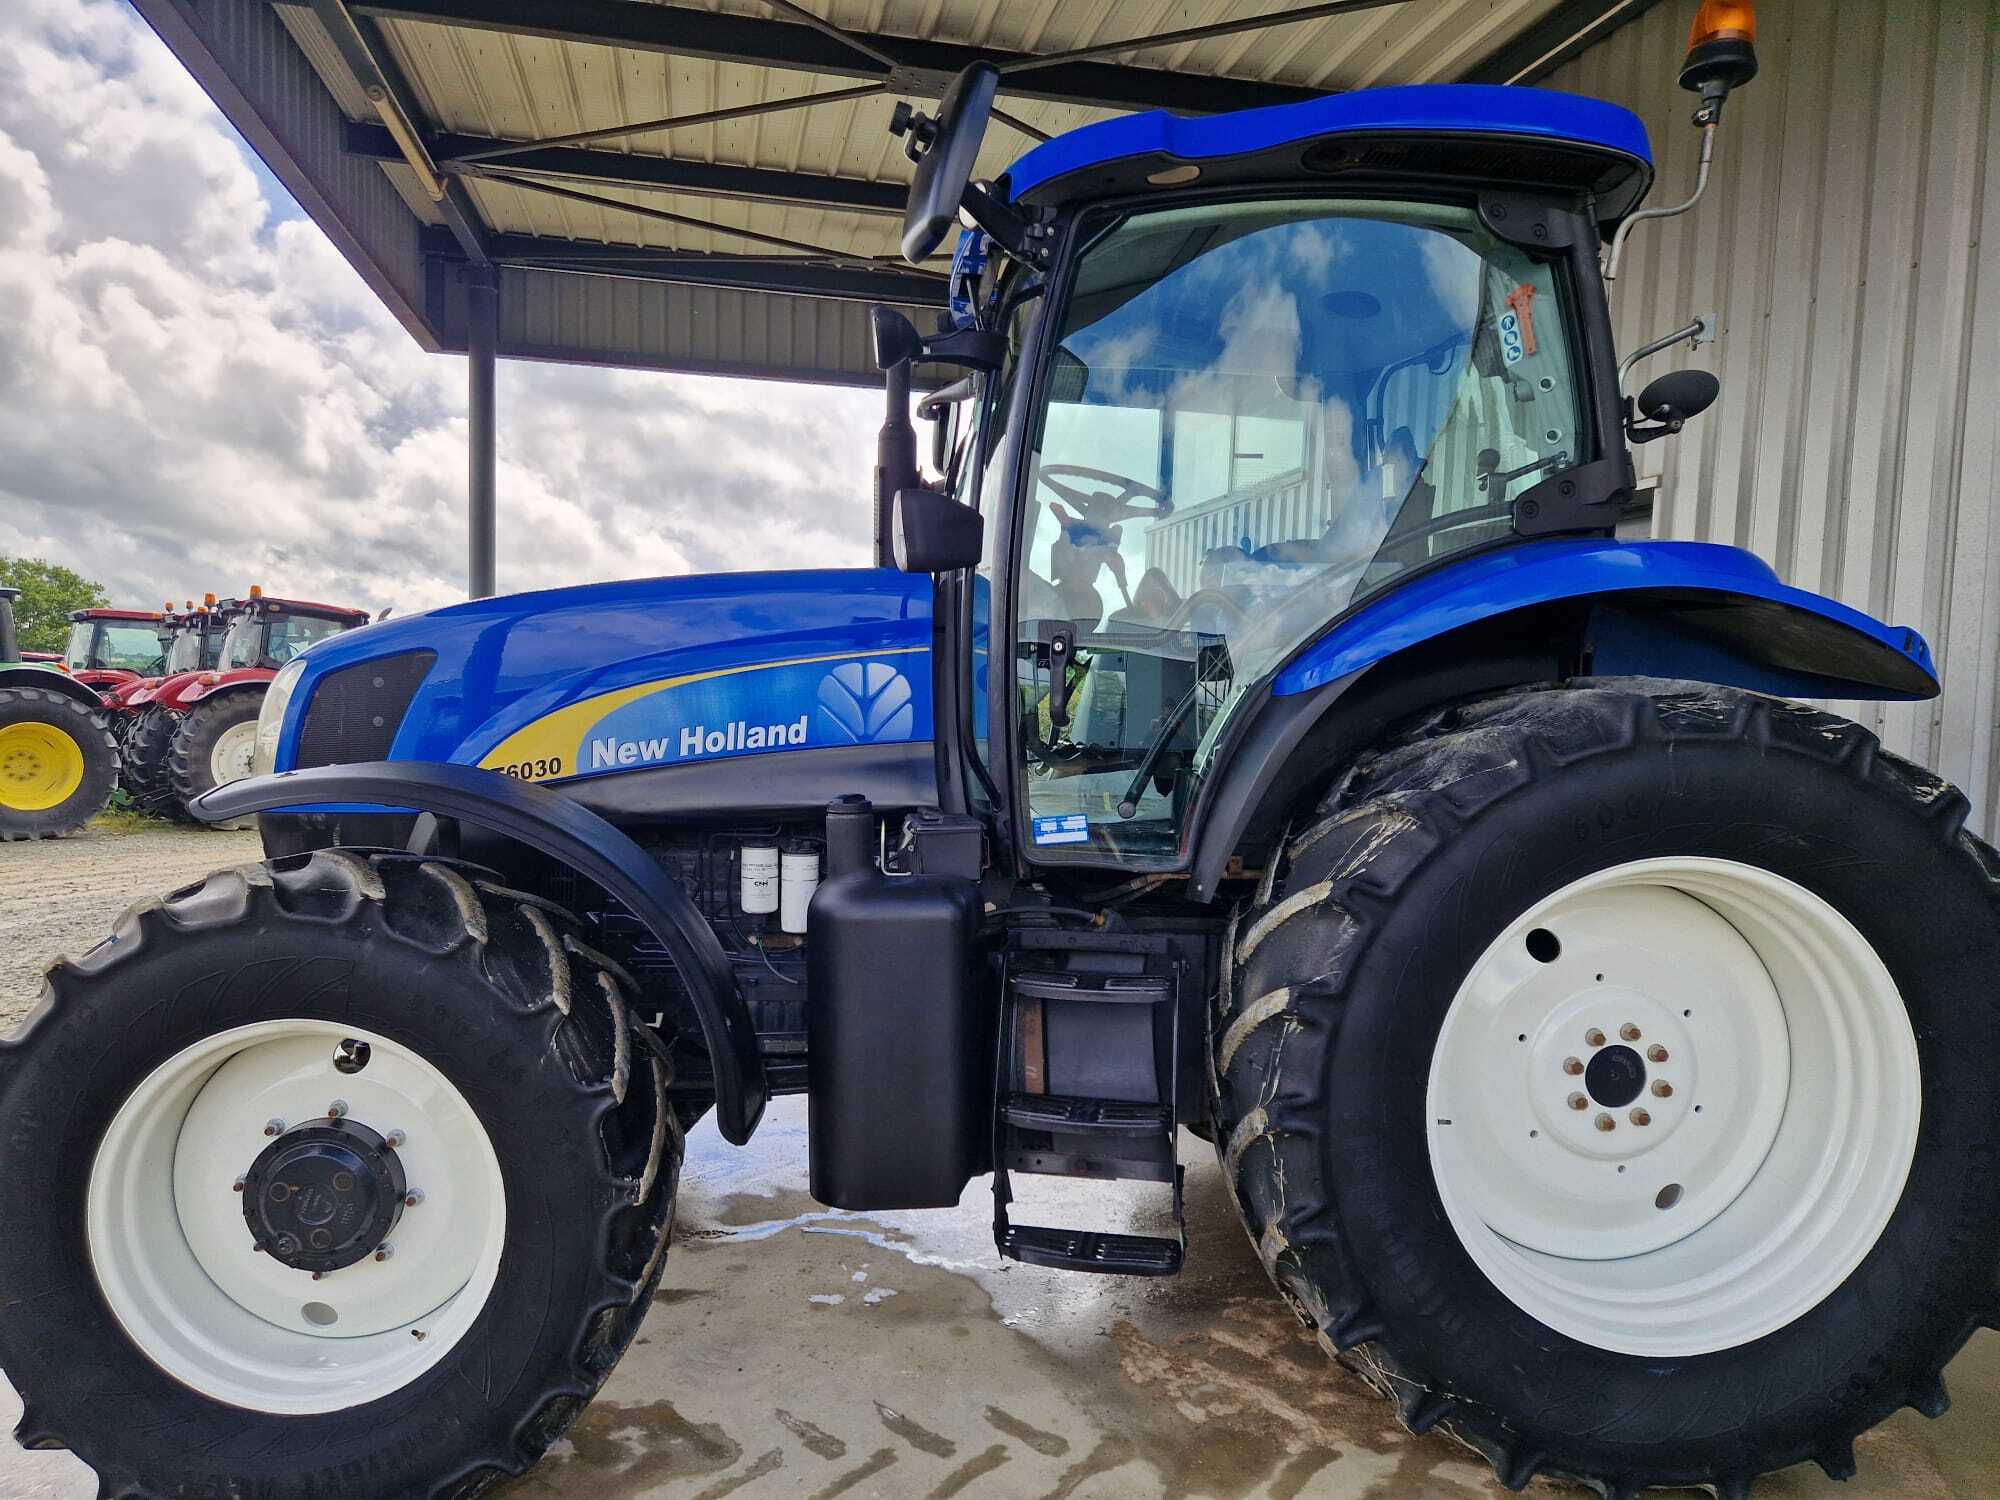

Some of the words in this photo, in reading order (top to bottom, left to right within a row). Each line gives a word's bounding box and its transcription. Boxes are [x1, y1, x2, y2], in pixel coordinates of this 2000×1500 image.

[591, 737, 668, 769] New
[679, 715, 808, 756] Holland
[490, 757, 562, 781] 6030
